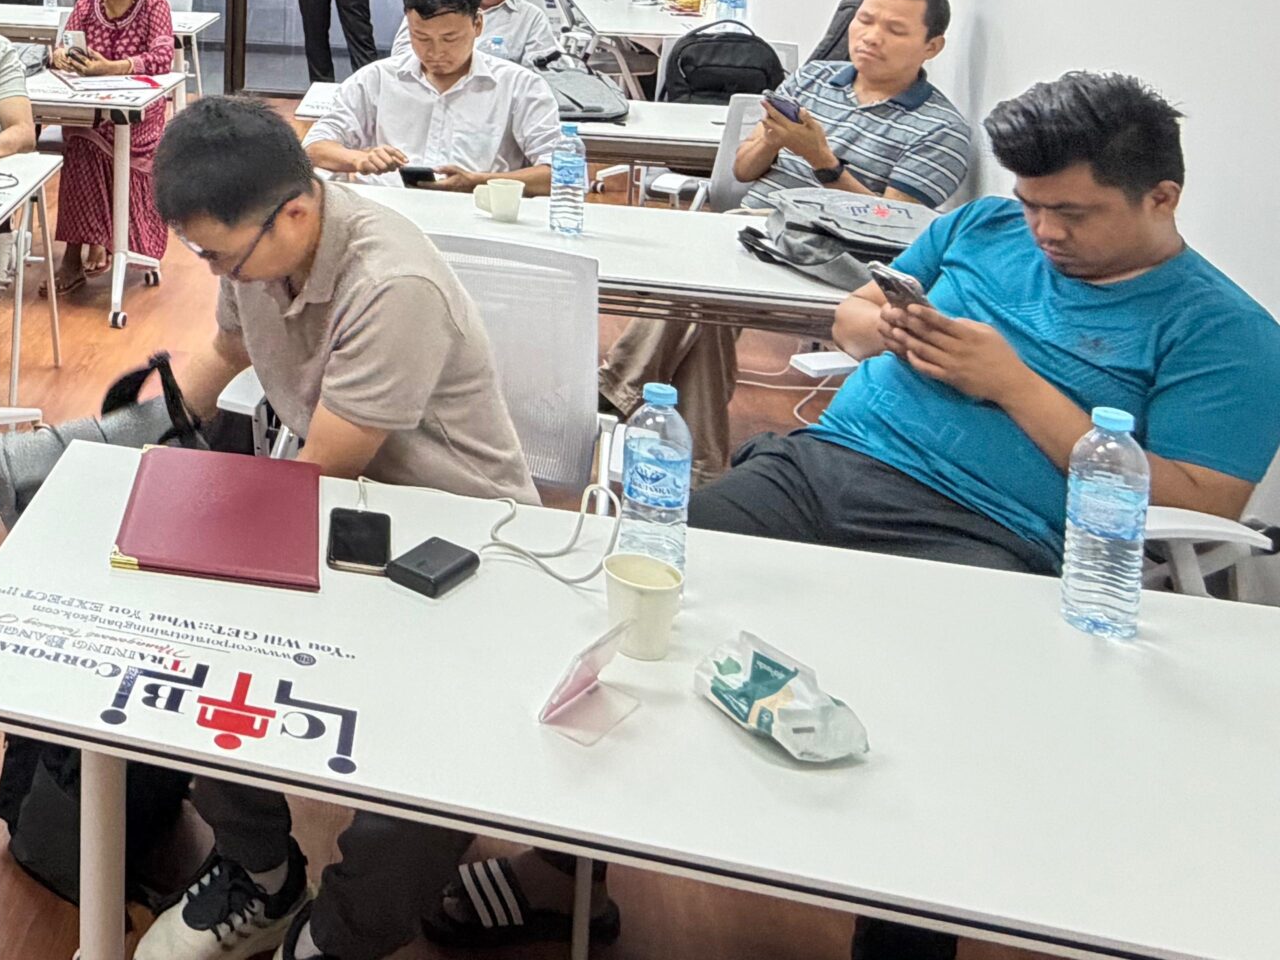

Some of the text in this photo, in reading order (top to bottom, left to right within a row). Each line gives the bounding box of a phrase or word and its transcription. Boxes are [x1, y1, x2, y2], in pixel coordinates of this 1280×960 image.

[21, 588, 105, 612] EXPECT
[108, 605, 142, 620] You
[23, 617, 83, 638] Training
[33, 605, 291, 661] www.corporatetrainingbangkok.com
[85, 631, 192, 659] Management
[264, 634, 302, 651] Will
[307, 642, 357, 660] “You
[72, 639, 187, 673] TRAINING
